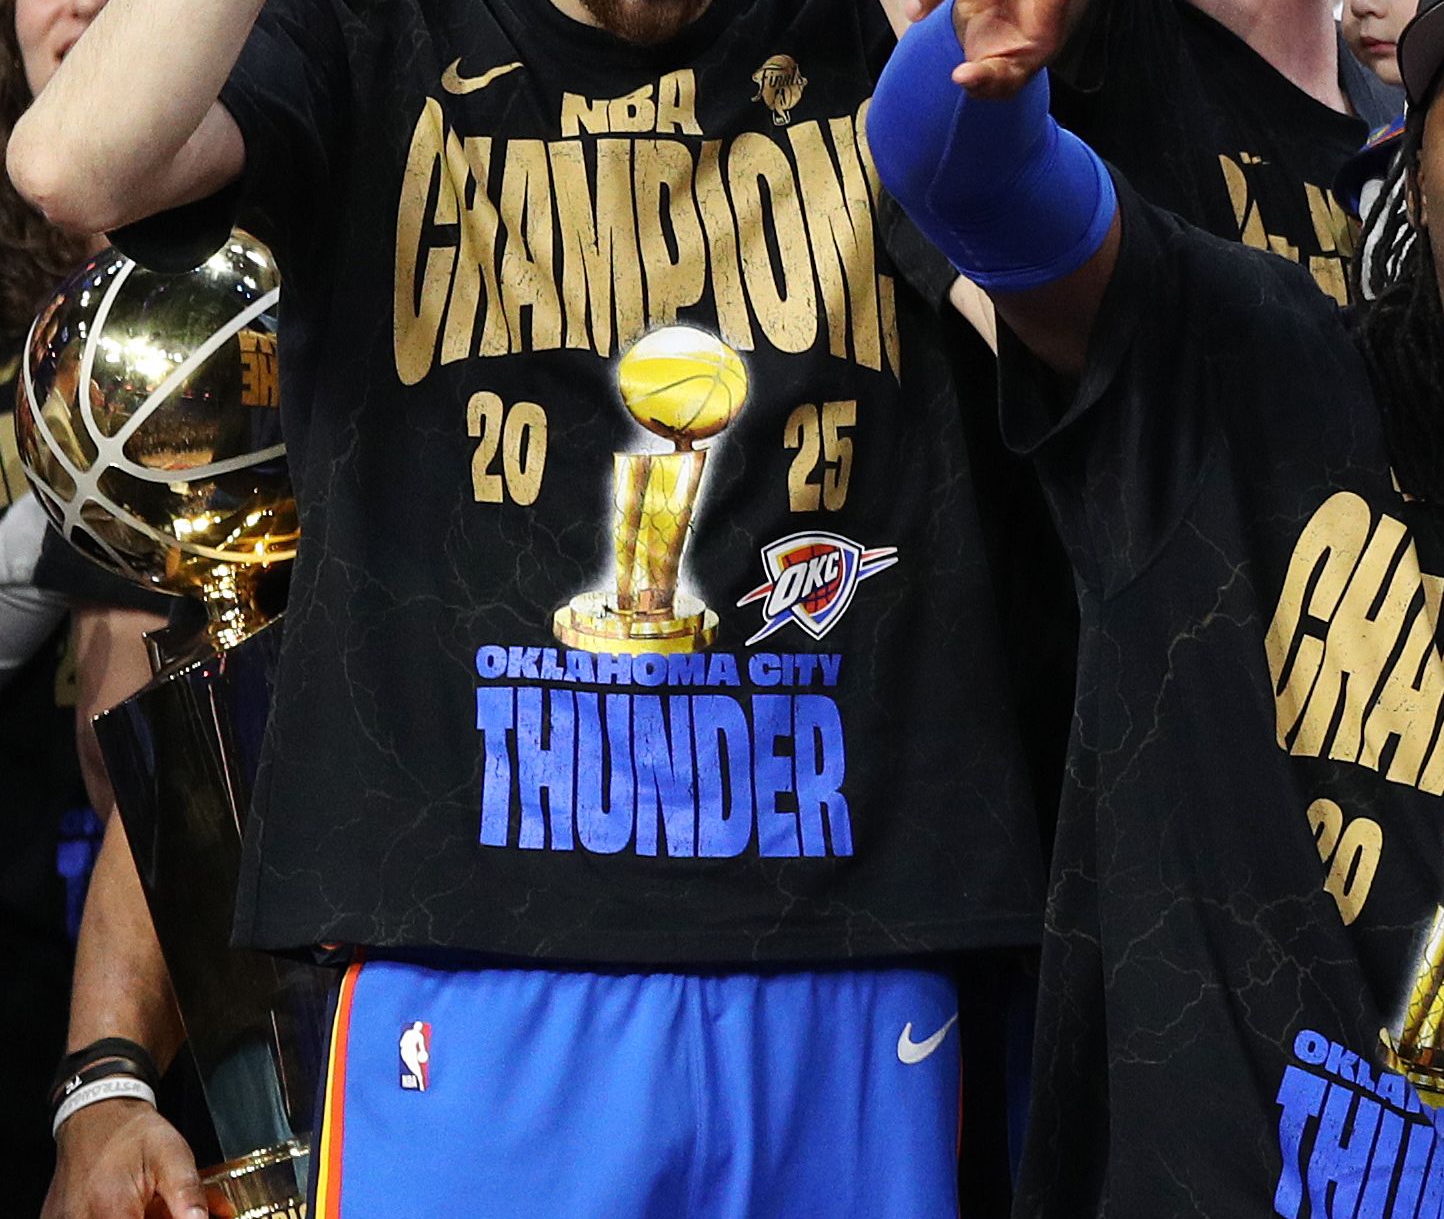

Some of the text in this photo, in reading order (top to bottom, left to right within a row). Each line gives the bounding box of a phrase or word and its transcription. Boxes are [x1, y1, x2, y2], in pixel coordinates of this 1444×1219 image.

[561, 68, 703, 138] NBA
[467, 390, 548, 506] 20
[784, 399, 857, 512] 25
[767, 549, 841, 616] OKC
[475, 646, 842, 686] OKLAHOMA CITY
[476, 686, 853, 857] THUNDER
